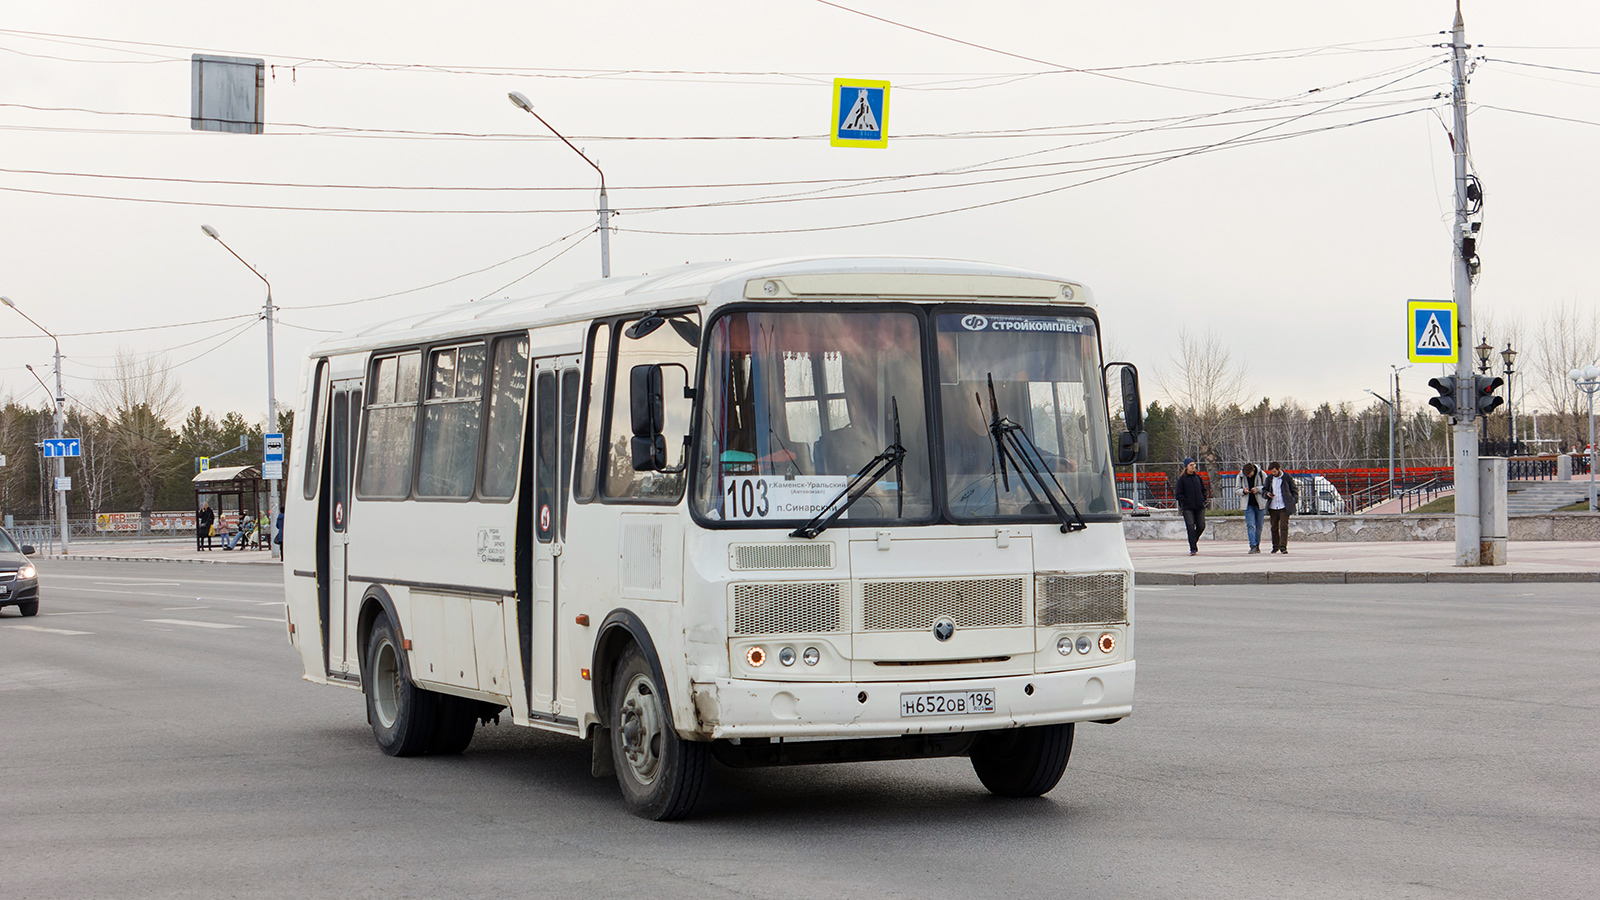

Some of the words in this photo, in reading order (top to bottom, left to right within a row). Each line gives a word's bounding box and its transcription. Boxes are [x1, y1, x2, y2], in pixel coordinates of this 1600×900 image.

[991, 319, 1084, 333] СТРОЙКОМПЛЕКТ
[727, 479, 769, 518] 103
[905, 695, 966, 714] Н652ОВ
[968, 692, 993, 706] 196
